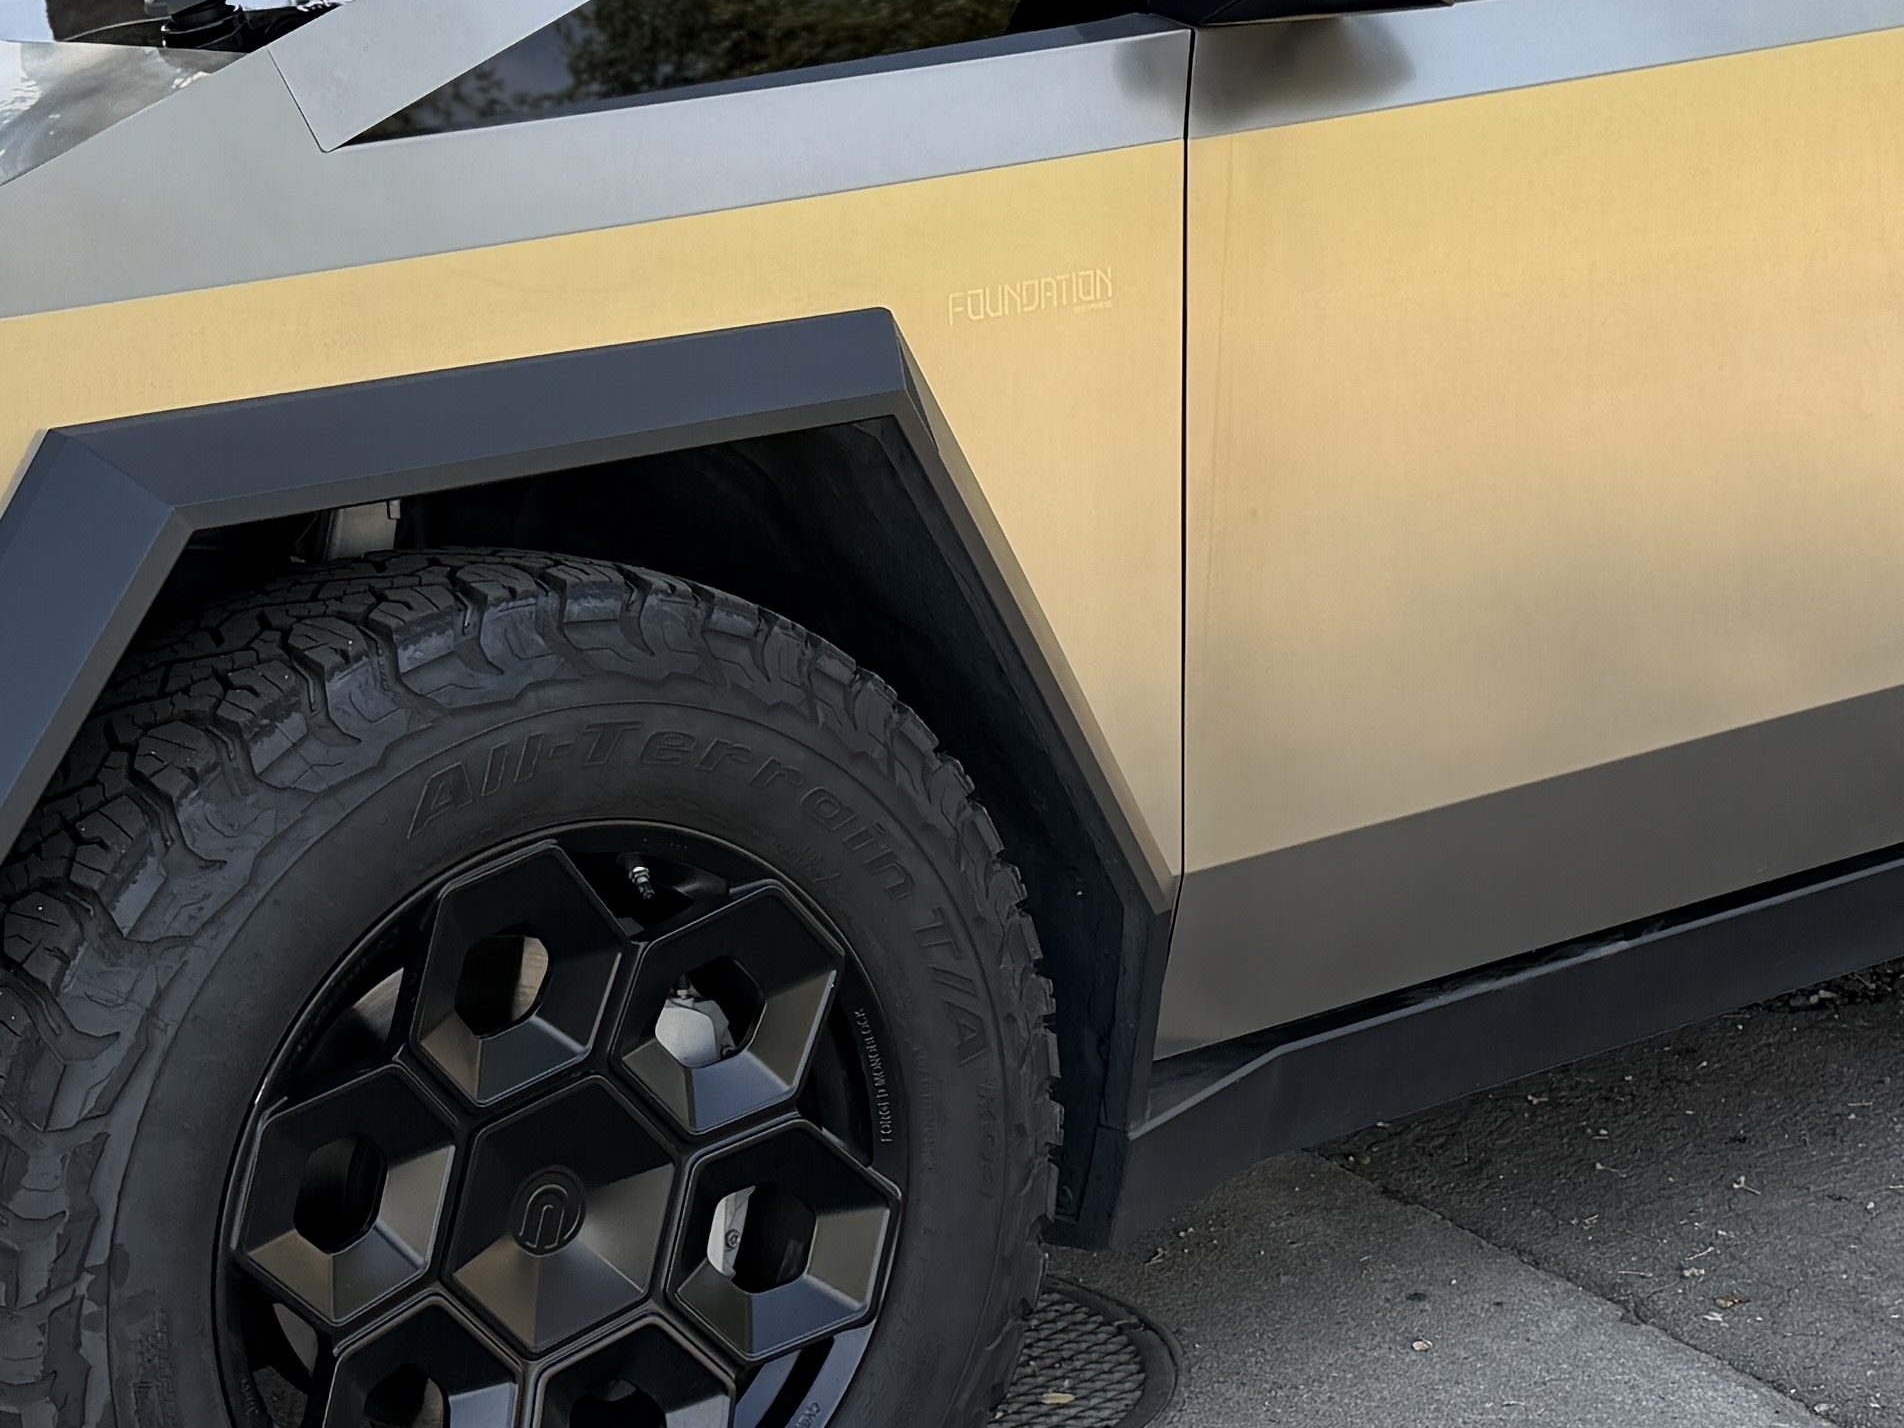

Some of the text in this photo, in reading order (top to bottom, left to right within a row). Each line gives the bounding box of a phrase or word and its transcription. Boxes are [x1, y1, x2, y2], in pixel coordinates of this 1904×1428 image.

[948, 265, 1113, 326] FOUNDATION
[407, 720, 914, 901] All-Terrain
[912, 905, 989, 1066] T/A
